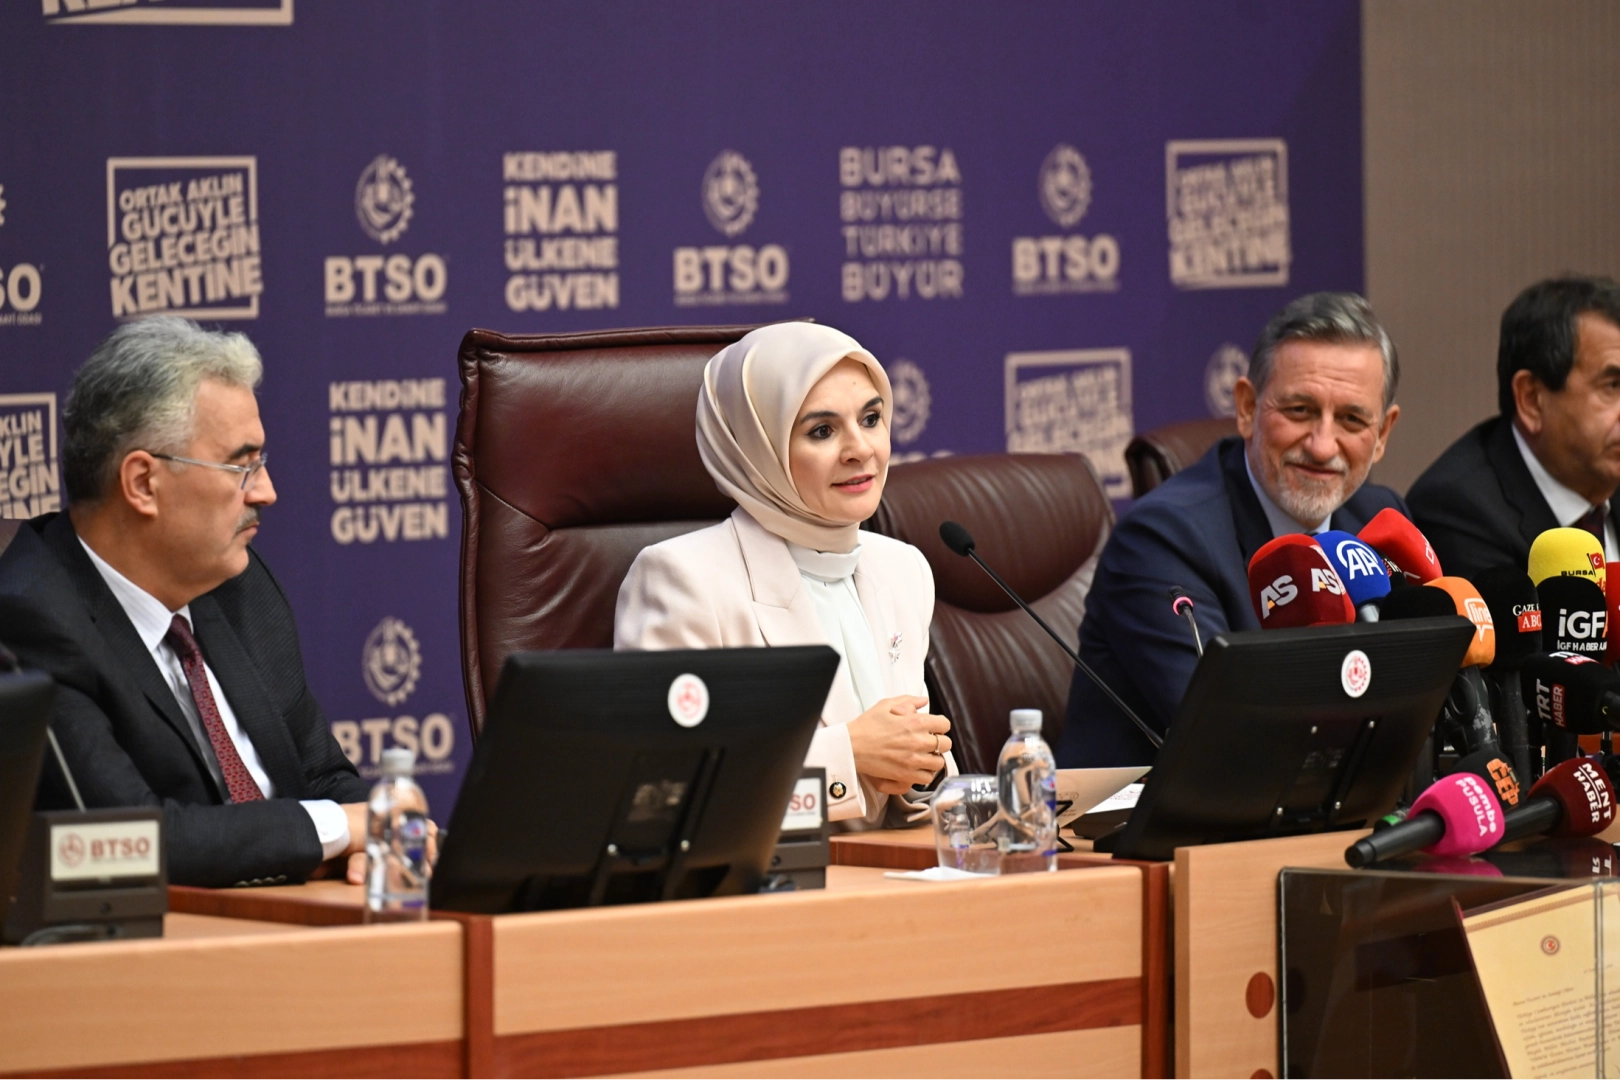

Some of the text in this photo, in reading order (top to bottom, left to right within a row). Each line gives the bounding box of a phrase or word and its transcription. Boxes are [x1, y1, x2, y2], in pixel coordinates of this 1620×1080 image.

[839, 145, 962, 187] BURSA
[119, 181, 183, 212] ORTAK
[324, 253, 448, 303] BTSO
[673, 245, 789, 293] BTSO
[1012, 234, 1120, 282] BTSO
[1310, 567, 1344, 595] AS
[1346, 547, 1385, 580] AA
[1261, 574, 1298, 619] AS
[1572, 642, 1599, 651] HABER
[1536, 678, 1552, 720] TRT
[1552, 686, 1565, 727] HABER
[331, 713, 454, 767] BTSO
[1455, 779, 1488, 837] PUSULA
[1573, 770, 1601, 823] HABER
[1582, 762, 1612, 820] MENT
[91, 836, 151, 858] BTSO
